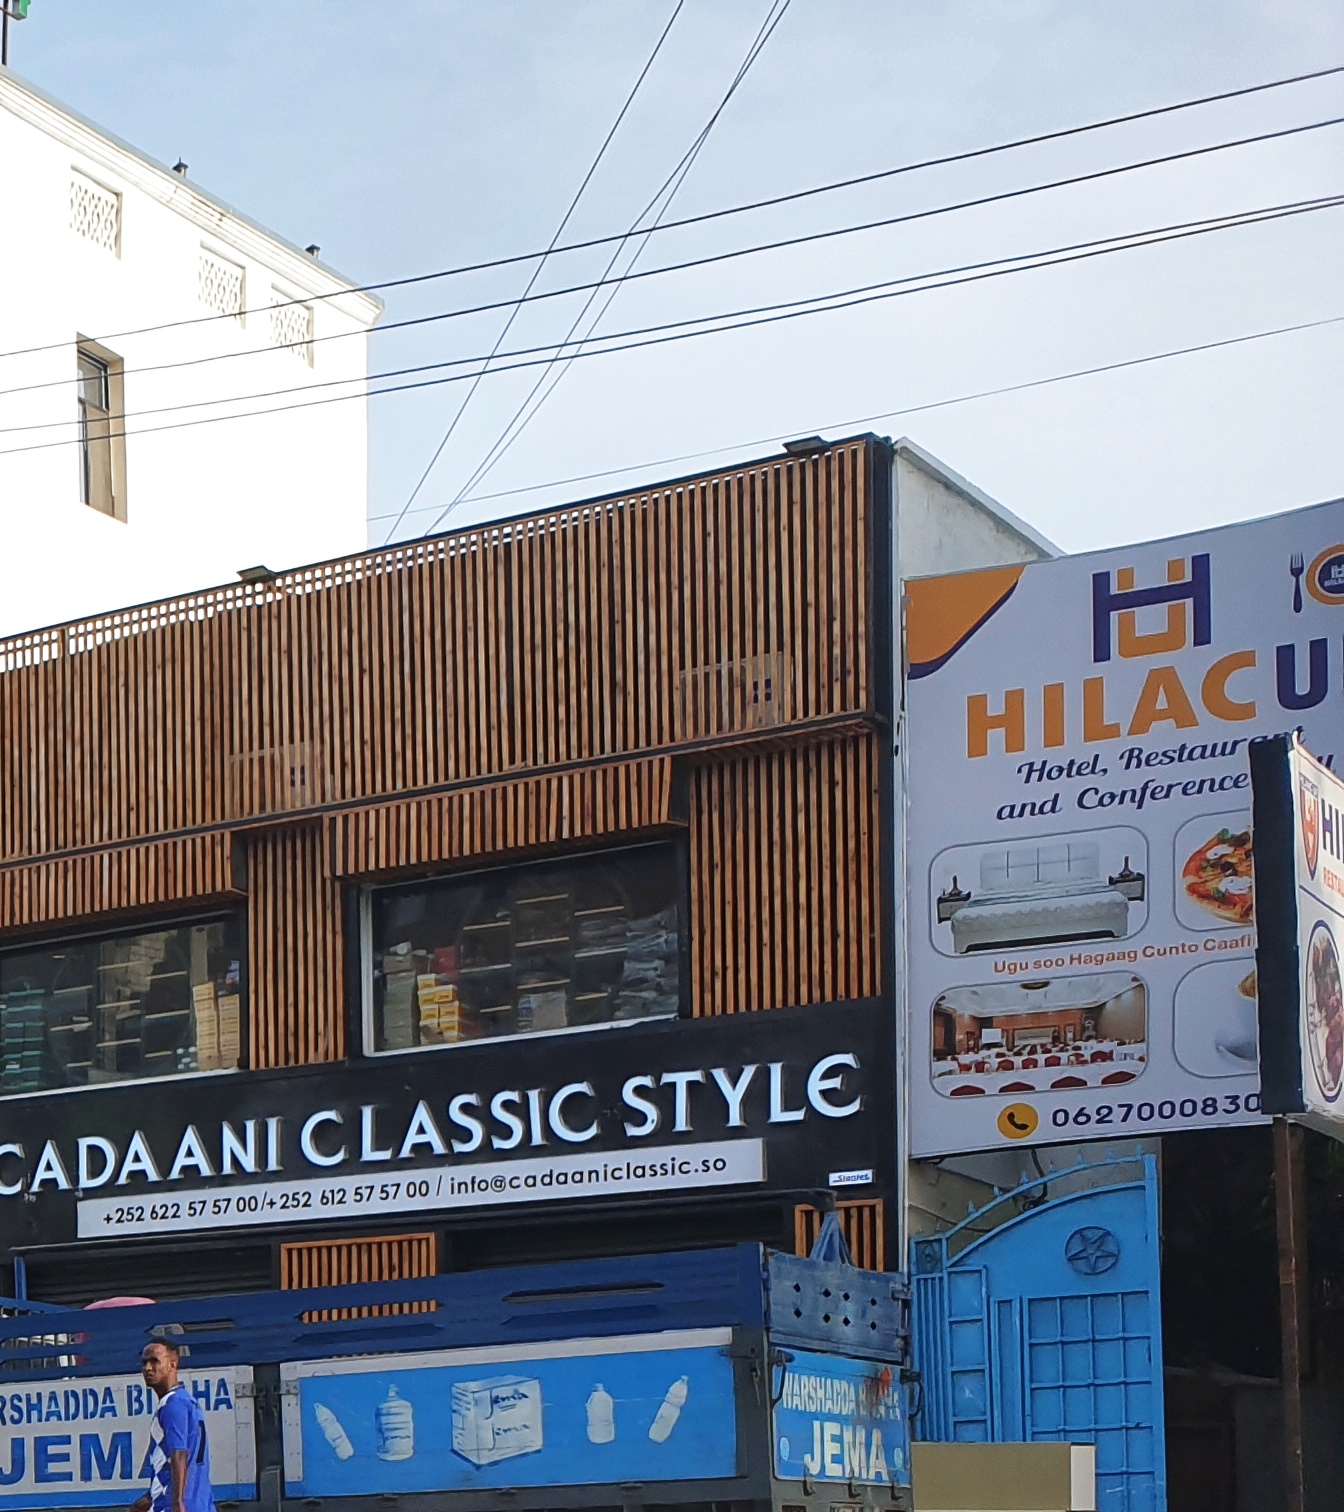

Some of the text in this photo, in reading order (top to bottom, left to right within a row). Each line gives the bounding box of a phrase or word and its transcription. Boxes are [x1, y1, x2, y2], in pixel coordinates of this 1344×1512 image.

[966, 630, 1344, 759] HILACU
[1016, 753, 1108, 784] Hotel,
[1118, 725, 1306, 771] Restaurt
[996, 772, 1250, 821] and Conference
[993, 960, 1029, 975] Ugu
[1032, 957, 1065, 969] soo
[1142, 941, 1199, 958] Cunto
[1203, 933, 1255, 951] Caafi
[300, 1081, 601, 1167] CLASSIC
[621, 1052, 865, 1138] STYLE
[150, 1202, 182, 1222] 622
[320, 1188, 347, 1206] 612
[406, 1179, 430, 1198] 00
[449, 1156, 727, 1196] info@cadaaniclassic.so
[126, 1377, 234, 1417] BIHA
[803, 1419, 890, 1483] JEMA
